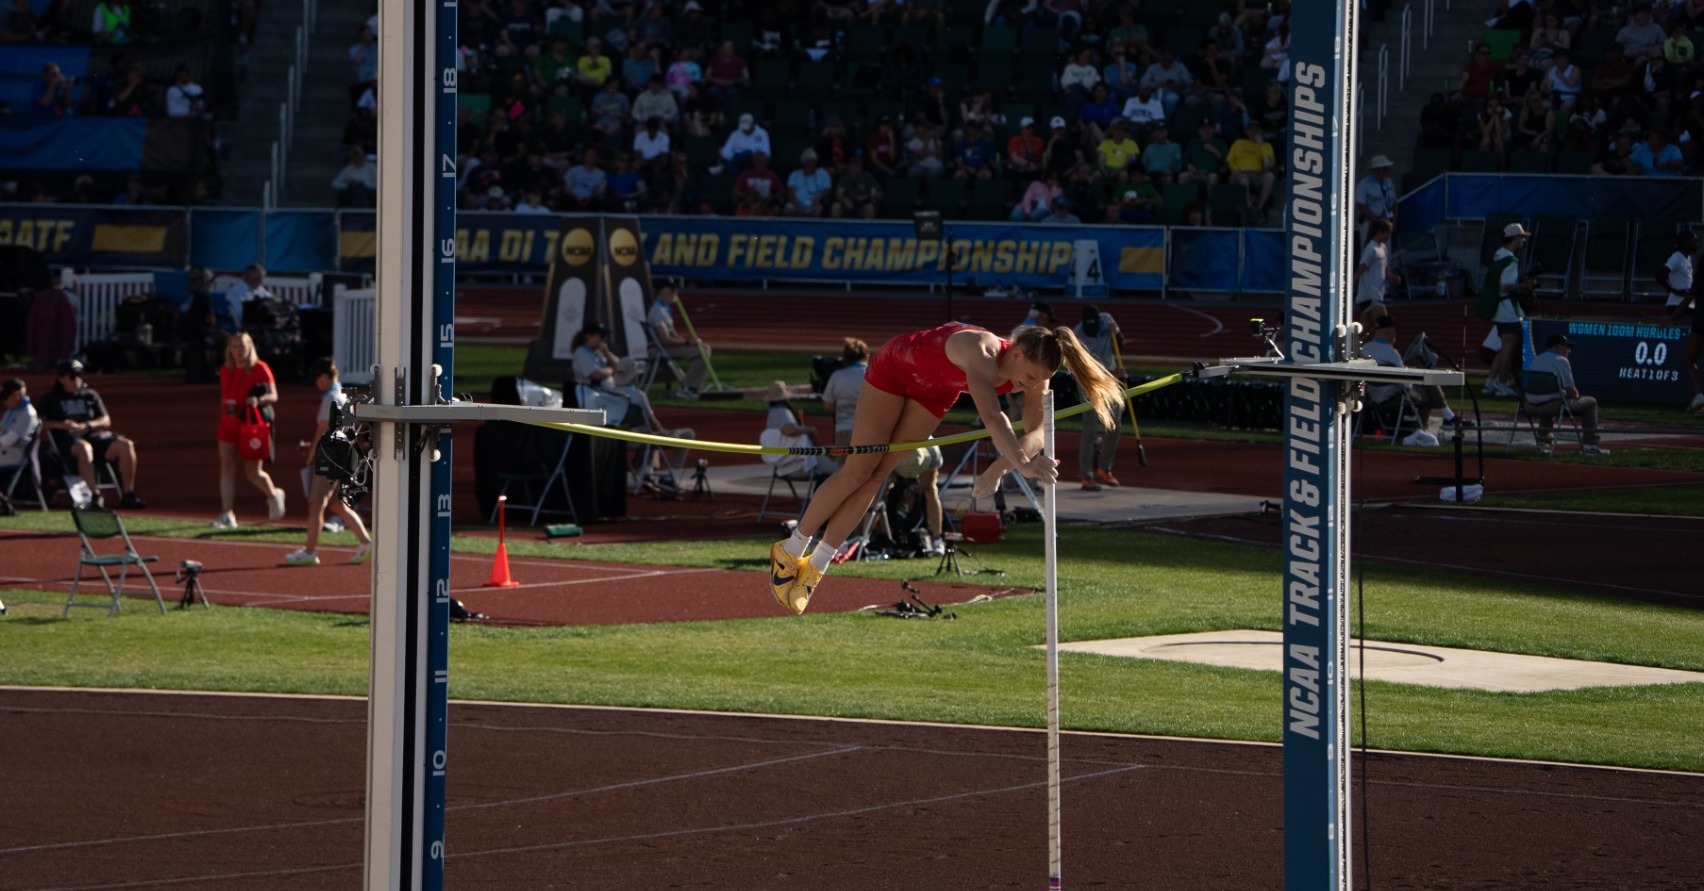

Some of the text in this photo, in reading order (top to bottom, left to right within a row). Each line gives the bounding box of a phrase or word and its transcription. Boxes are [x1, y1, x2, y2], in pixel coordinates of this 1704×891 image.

[443, 68, 457, 94] 18
[442, 153, 456, 178] 17
[441, 238, 455, 264] 16
[651, 231, 720, 268] AND
[725, 233, 815, 270] FIELD
[820, 235, 1074, 275] CHAMPIONSHIP
[1086, 257, 1101, 284] 4
[440, 323, 454, 348] 15
[1568, 321, 1605, 336] WOMEN
[1607, 323, 1635, 337] 100M
[1635, 325, 1681, 340] HURDLES
[1635, 340, 1668, 366] 0.0
[1619, 366, 1647, 380] HEAT
[1671, 369, 1679, 382] 3
[1289, 61, 1326, 740] NCAA TRACK & FIELD CHAMPIONSHIPS
[437, 494, 451, 518] 13
[436, 578, 450, 604] 12
[434, 670, 448, 684] 11
[1326, 660, 1333, 686] 10
[433, 749, 447, 777] 10
[431, 839, 445, 860] 9
